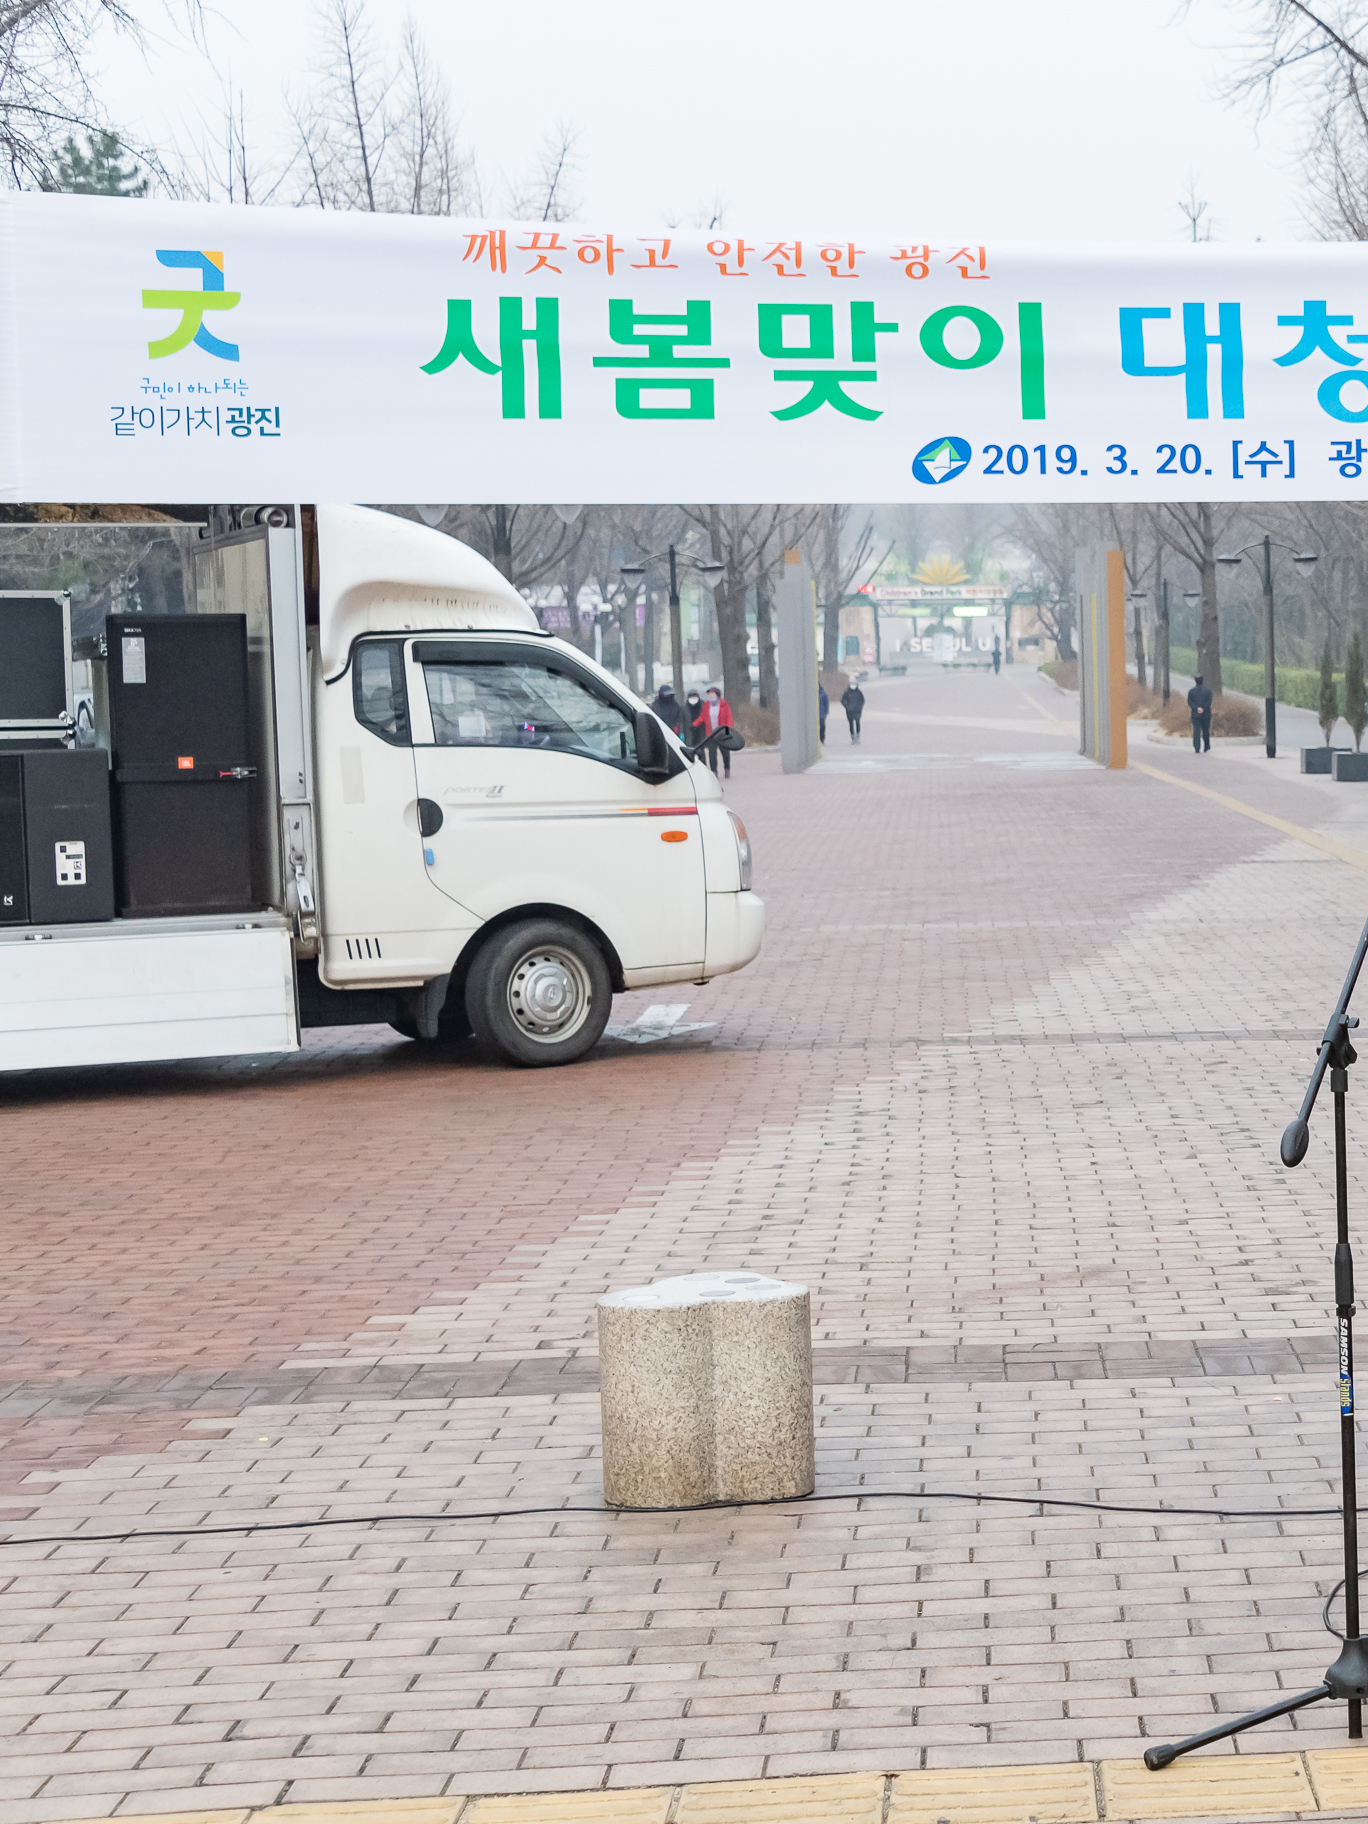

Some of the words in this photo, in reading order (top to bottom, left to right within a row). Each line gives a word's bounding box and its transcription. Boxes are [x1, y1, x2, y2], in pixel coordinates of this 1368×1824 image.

[463, 230, 679, 276] 깨끗하고
[706, 236, 866, 278] 안전한
[889, 244, 991, 280] 광진
[418, 295, 1047, 422] 새봄맞이
[140, 377, 181, 400] 구민이
[187, 378, 249, 397] 하나되는
[110, 405, 220, 437] 같이가치
[225, 406, 282, 438] 광진
[982, 443, 1089, 477] 2019.
[1105, 443, 1139, 477] 3.
[1155, 443, 1213, 477] 20.
[1231, 440, 1296, 479] [수]
[909, 636, 972, 653] SEUL
[1340, 1317, 1349, 1376] SAMSON
[1340, 1378, 1352, 1408] stands
